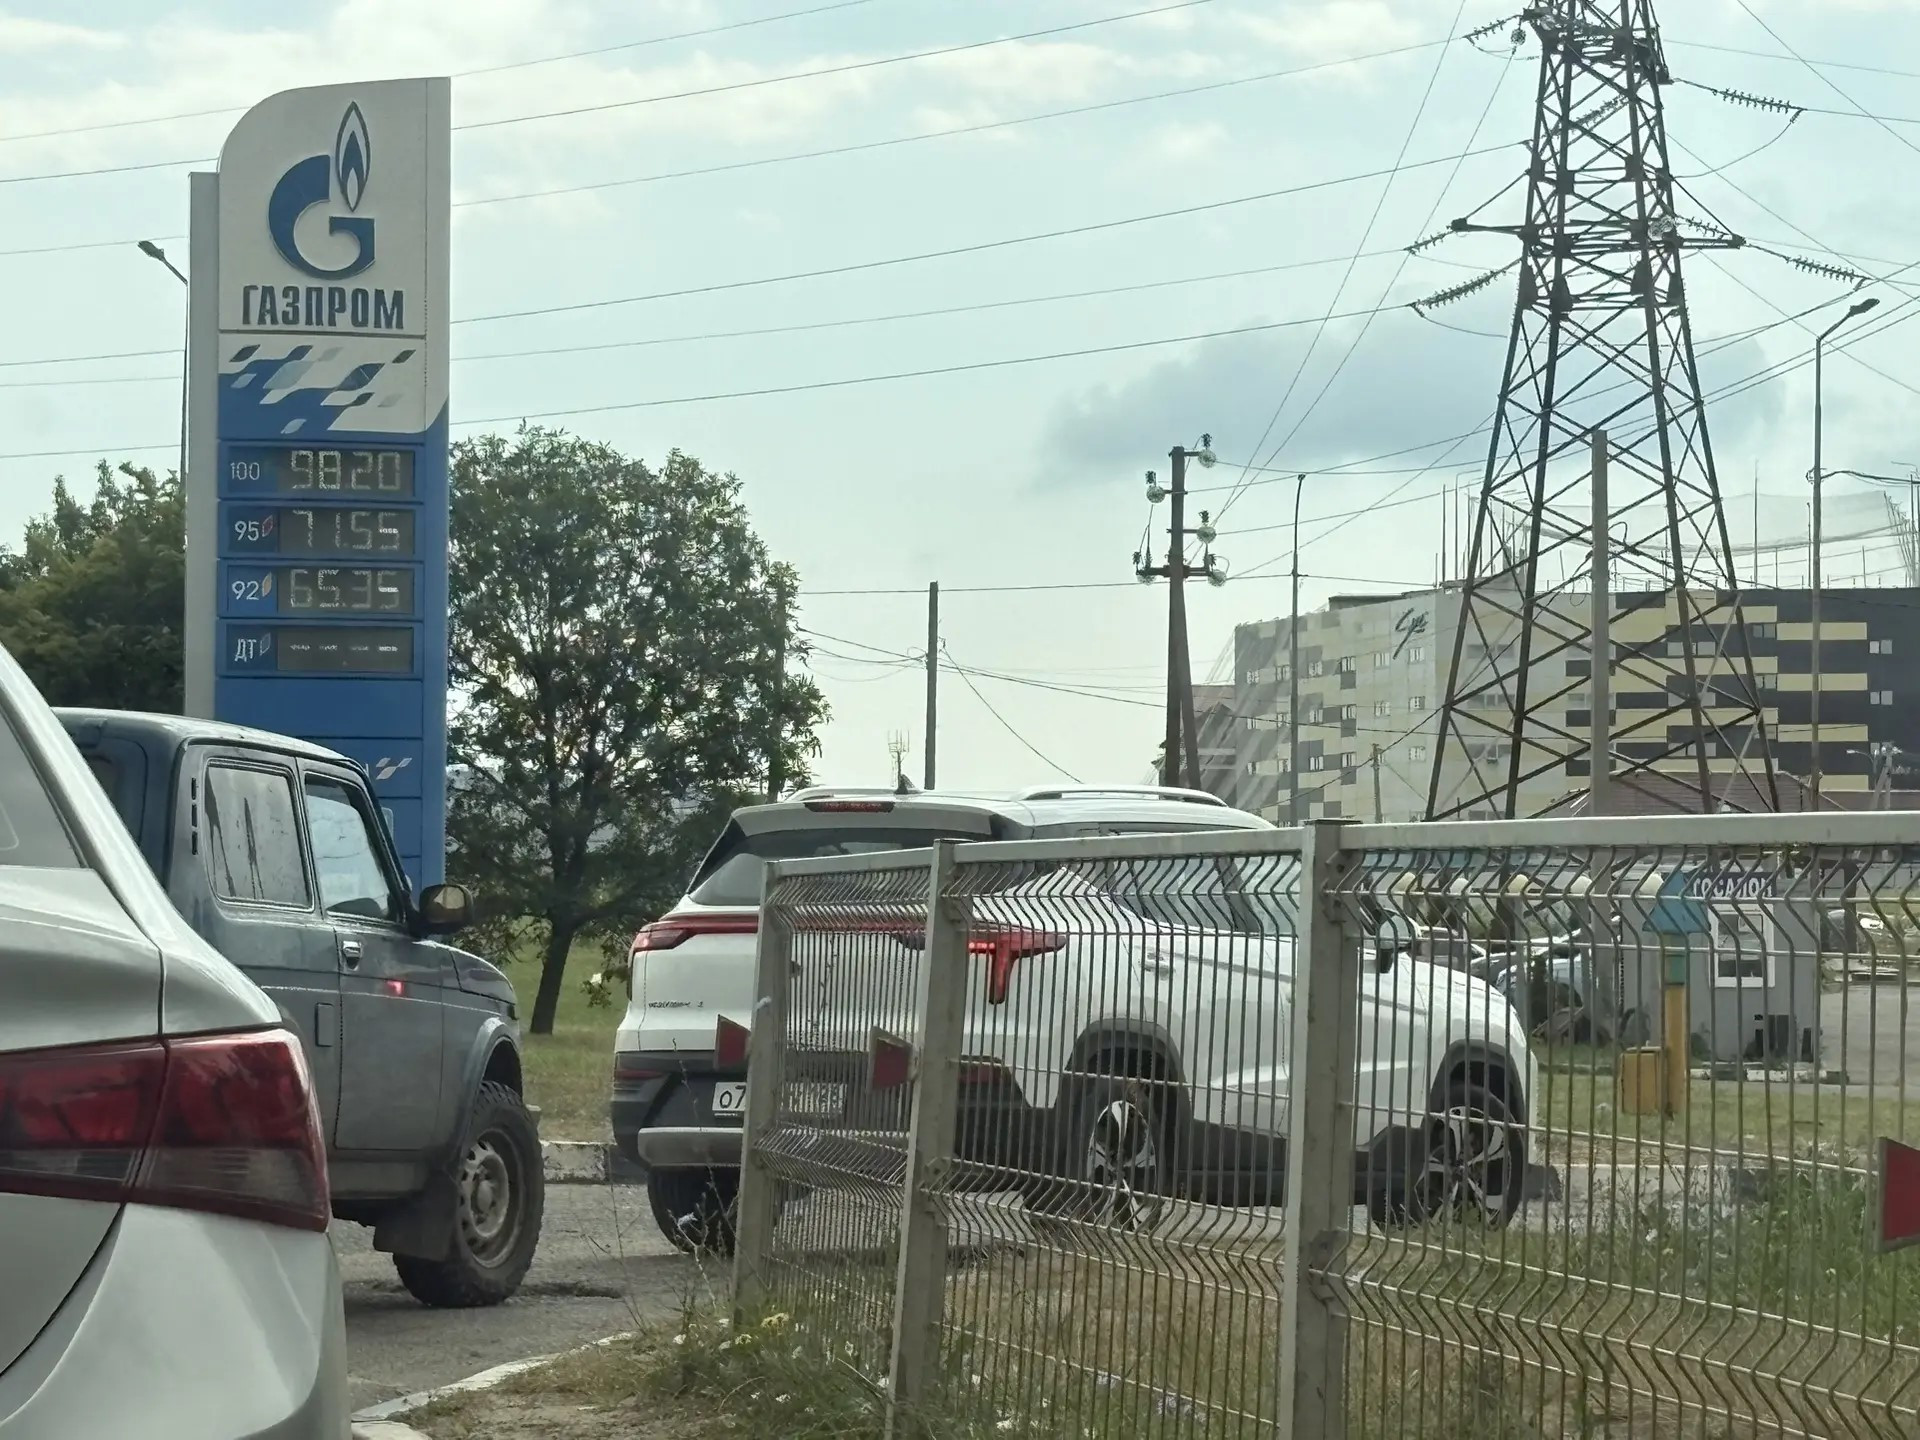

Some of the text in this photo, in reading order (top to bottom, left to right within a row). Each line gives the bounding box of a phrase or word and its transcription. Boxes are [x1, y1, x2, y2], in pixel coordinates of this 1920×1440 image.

[241, 284, 405, 330] ГАЗПРОМ
[230, 461, 260, 481] 100
[234, 520, 260, 542] 95
[231, 580, 260, 601] 92
[234, 638, 257, 662] ДТ
